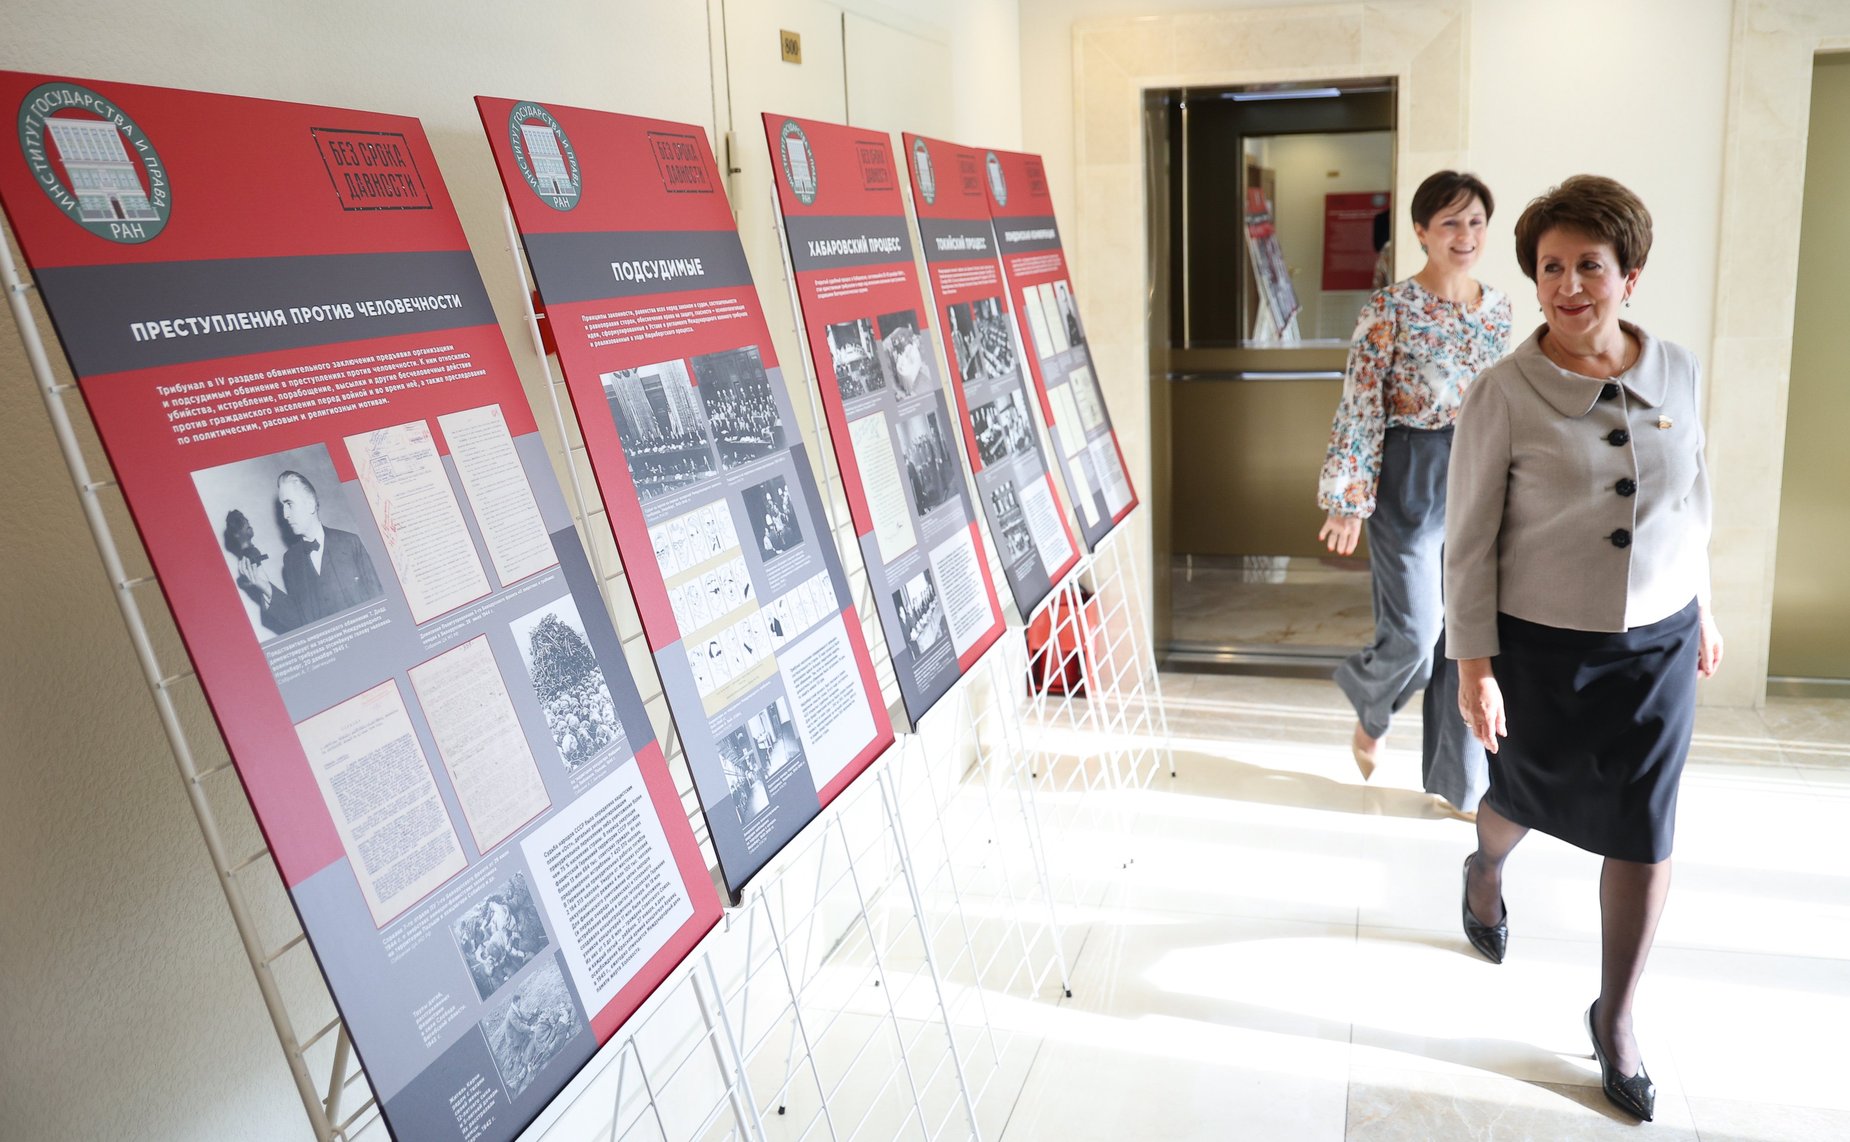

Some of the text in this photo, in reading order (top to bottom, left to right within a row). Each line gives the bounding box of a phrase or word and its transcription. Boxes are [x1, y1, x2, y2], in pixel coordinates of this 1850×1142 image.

[25, 115, 76, 211] ИНСТИТУТ
[30, 90, 166, 207] ГОСУДАРСТВА И ПРАВА
[328, 140, 405, 169] БЕЗ СРОКА
[512, 123, 537, 188] ИНСТИТУТ
[514, 106, 578, 186] ГОСУДАРСТВА И ПРАВА
[344, 171, 418, 200] ДАВНОСТИ
[553, 197, 570, 208] РАН
[110, 222, 146, 239] РАН
[808, 235, 902, 257] ХАБАРОВСКИЙ ПРОЦЕСС
[610, 258, 705, 284] ПОДСУДИМЫЕ
[129, 294, 463, 342] ПРЕСТУПЛЕНИЯ ПРОТИВ ЧЕЛОВЕЧНОСТИ
[156, 382, 205, 396] Трибунал
[215, 377, 225, 386] IV
[228, 373, 264, 386] разделе
[266, 363, 331, 378] обвинительного
[332, 356, 375, 368] заключения
[412, 345, 454, 356] организациям
[171, 390, 232, 406] подсудимым
[233, 382, 280, 396] обвинение
[288, 372, 346, 387] преступлениях
[346, 368, 372, 377] против
[372, 361, 419, 372] человечности.
[167, 406, 216, 422] убийства,
[217, 395, 277, 411] истребление,
[278, 385, 335, 400] порабощение,
[335, 379, 367, 390] высылки
[374, 374, 397, 384] другие
[398, 366, 445, 379] бесчеловечные
[172, 420, 208, 433] против
[209, 408, 272, 426] гражданского
[274, 400, 316, 413] населения
[317, 395, 341, 405] перед
[341, 389, 368, 400] войной
[384, 384, 405, 393] время
[177, 436, 190, 445] по
[192, 423, 261, 442] политическим,
[262, 415, 299, 429] расовым
[307, 404, 357, 420] религиозным
[358, 398, 390, 408] мотивам.
[574, 822, 584, 834] СССР
[617, 823, 626, 834] СССР
